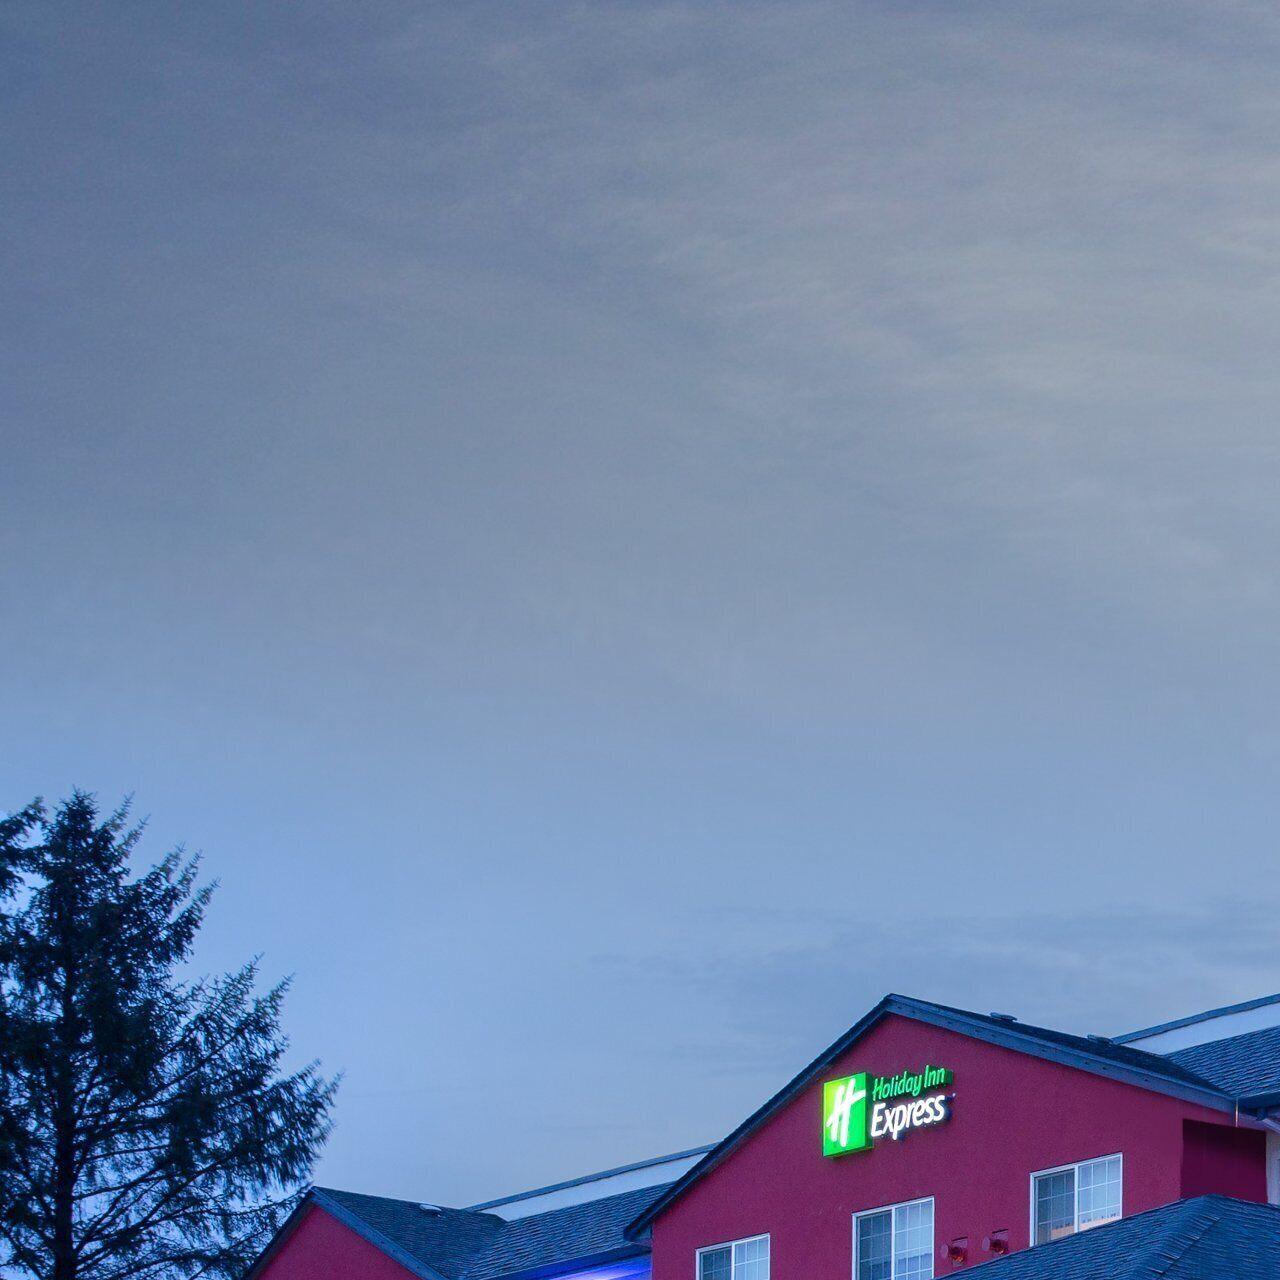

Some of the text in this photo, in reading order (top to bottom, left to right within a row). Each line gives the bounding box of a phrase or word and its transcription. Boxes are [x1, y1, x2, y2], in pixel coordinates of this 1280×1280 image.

[873, 1065, 946, 1101] Holiday Inn
[871, 1094, 945, 1140] Express
